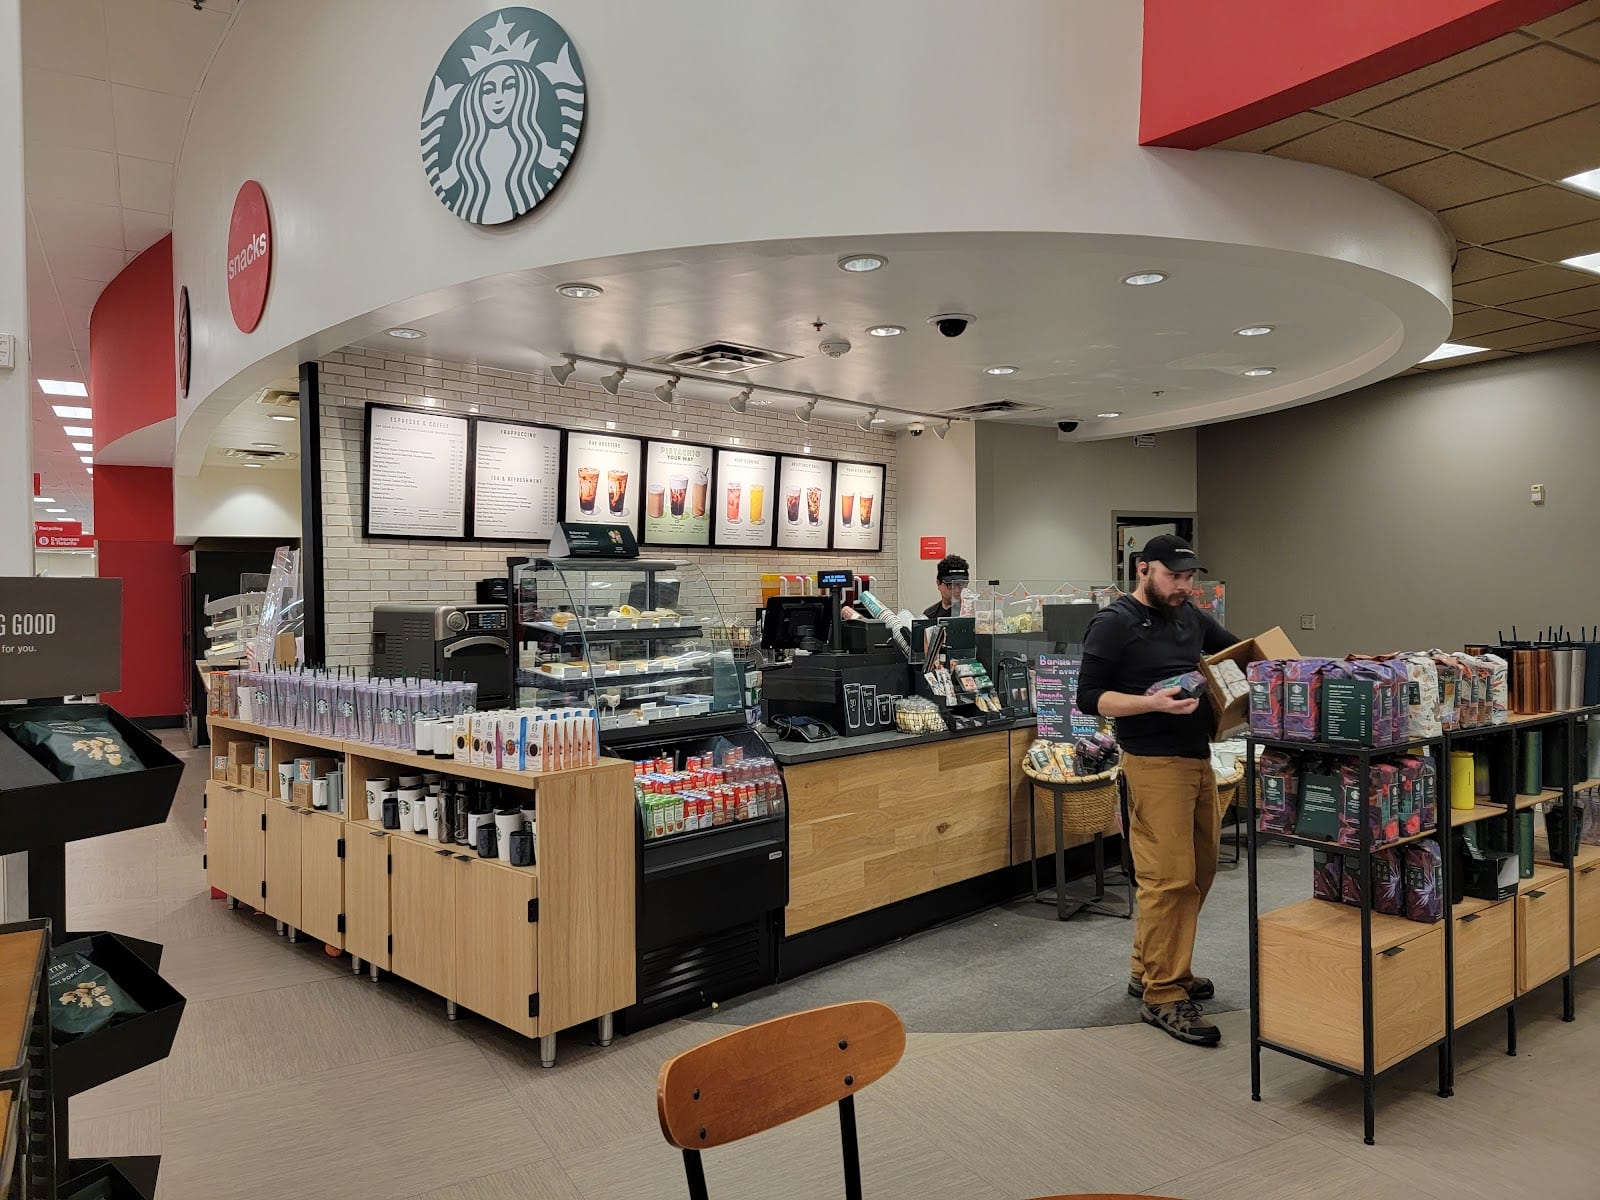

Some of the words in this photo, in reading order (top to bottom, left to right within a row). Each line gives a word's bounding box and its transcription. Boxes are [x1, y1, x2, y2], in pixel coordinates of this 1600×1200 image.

[228, 232, 267, 280] snacks
[500, 429, 536, 438] FRAPPUCCINO
[660, 446, 701, 457] PISTACHIO
[12, 613, 56, 635] GOOD
[2, 644, 15, 653] for
[17, 645, 37, 655] you.
[1039, 654, 1071, 666] Barista
[1052, 666, 1080, 675] Favori
[48, 962, 69, 974] TTER
[61, 963, 91, 982] POPCORN
